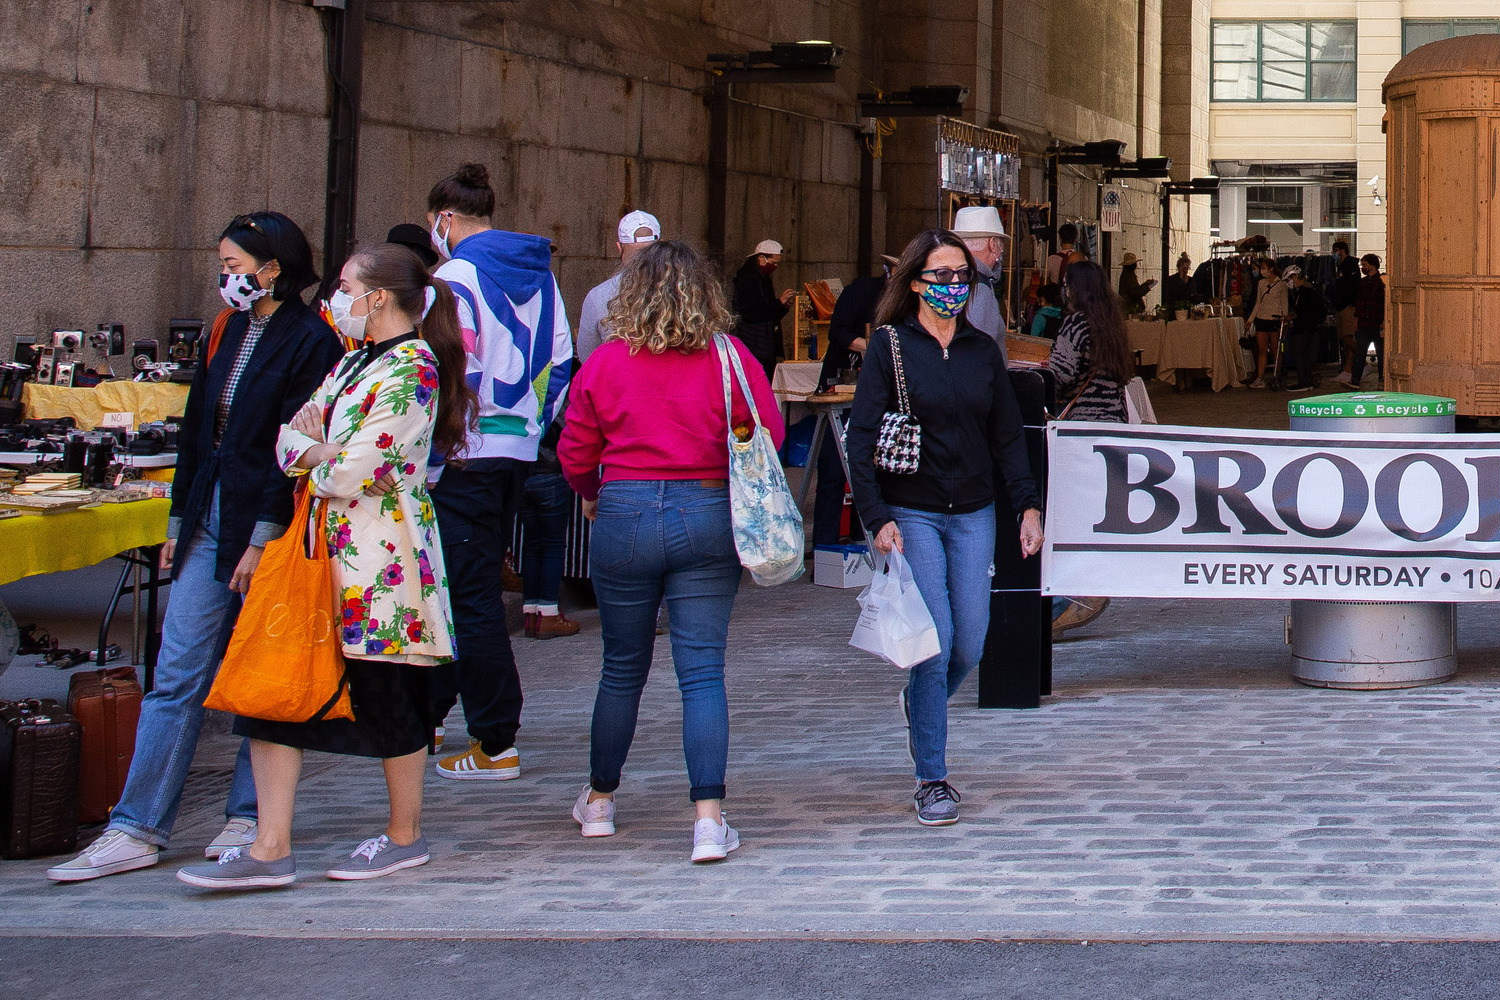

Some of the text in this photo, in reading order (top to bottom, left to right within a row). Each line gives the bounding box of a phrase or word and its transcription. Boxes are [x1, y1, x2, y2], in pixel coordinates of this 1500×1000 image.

[1299, 404, 1429, 416] Recycle Recycle
[111, 413, 122, 422] NO
[1184, 563, 1274, 585] EVERY
[1282, 563, 1431, 588] SATURDAY
